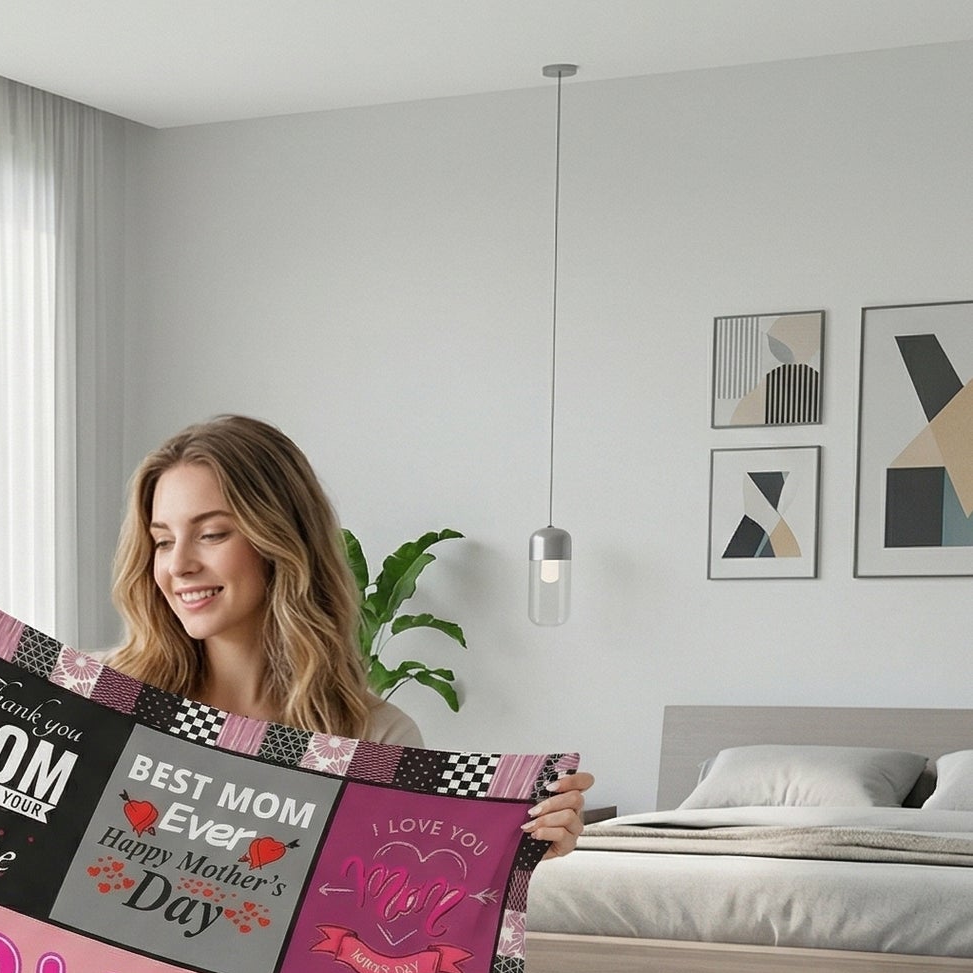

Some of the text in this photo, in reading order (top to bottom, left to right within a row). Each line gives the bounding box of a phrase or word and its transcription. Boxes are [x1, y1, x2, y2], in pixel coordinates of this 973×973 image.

[33, 717, 83, 742] you
[3, 790, 42, 817] YOUR
[128, 754, 316, 828] BEST MOM
[158, 802, 257, 850] Ever
[389, 819, 444, 835] LOVE
[451, 826, 488, 856] YOU
[98, 826, 287, 896] Happy Mother's
[122, 869, 224, 938] Day
